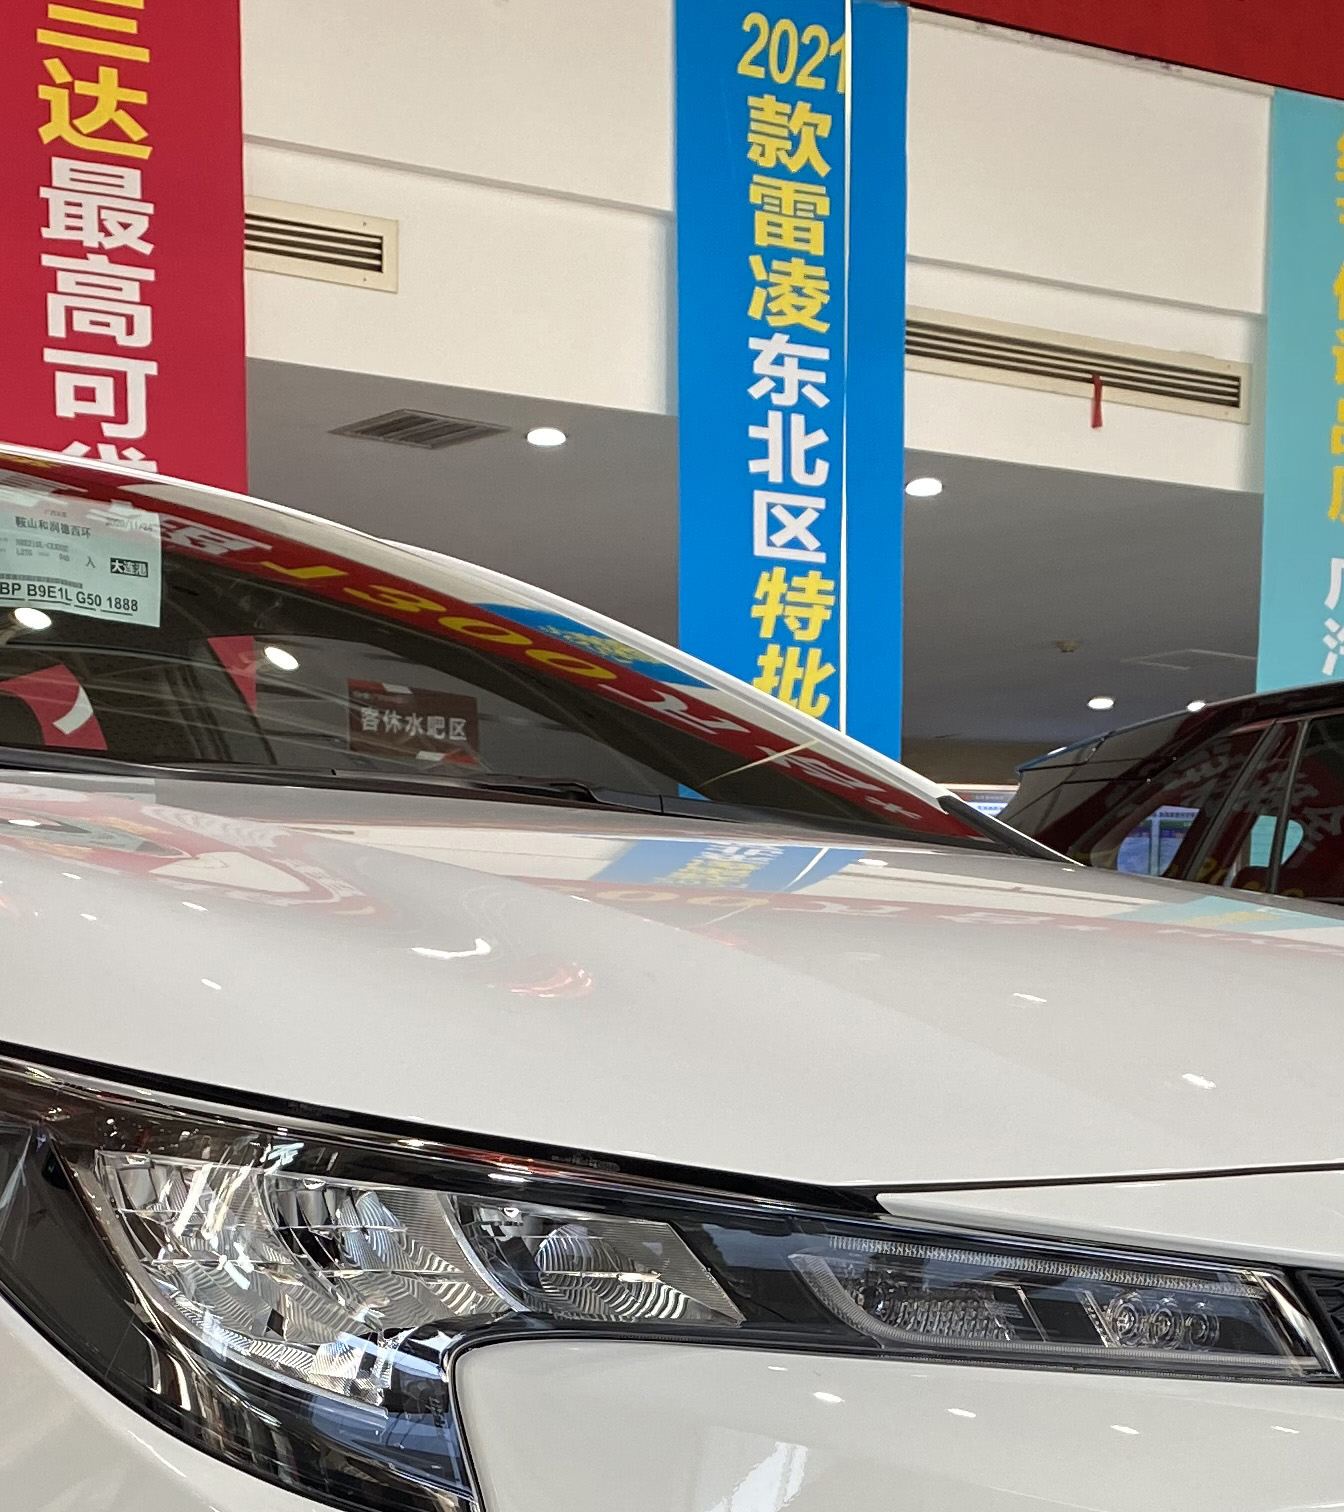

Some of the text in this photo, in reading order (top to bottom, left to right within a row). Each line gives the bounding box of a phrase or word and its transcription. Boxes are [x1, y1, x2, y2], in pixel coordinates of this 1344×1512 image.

[27, 583, 73, 601] B9E1L
[76, 593, 102, 607] G50
[106, 596, 138, 612] 1888
